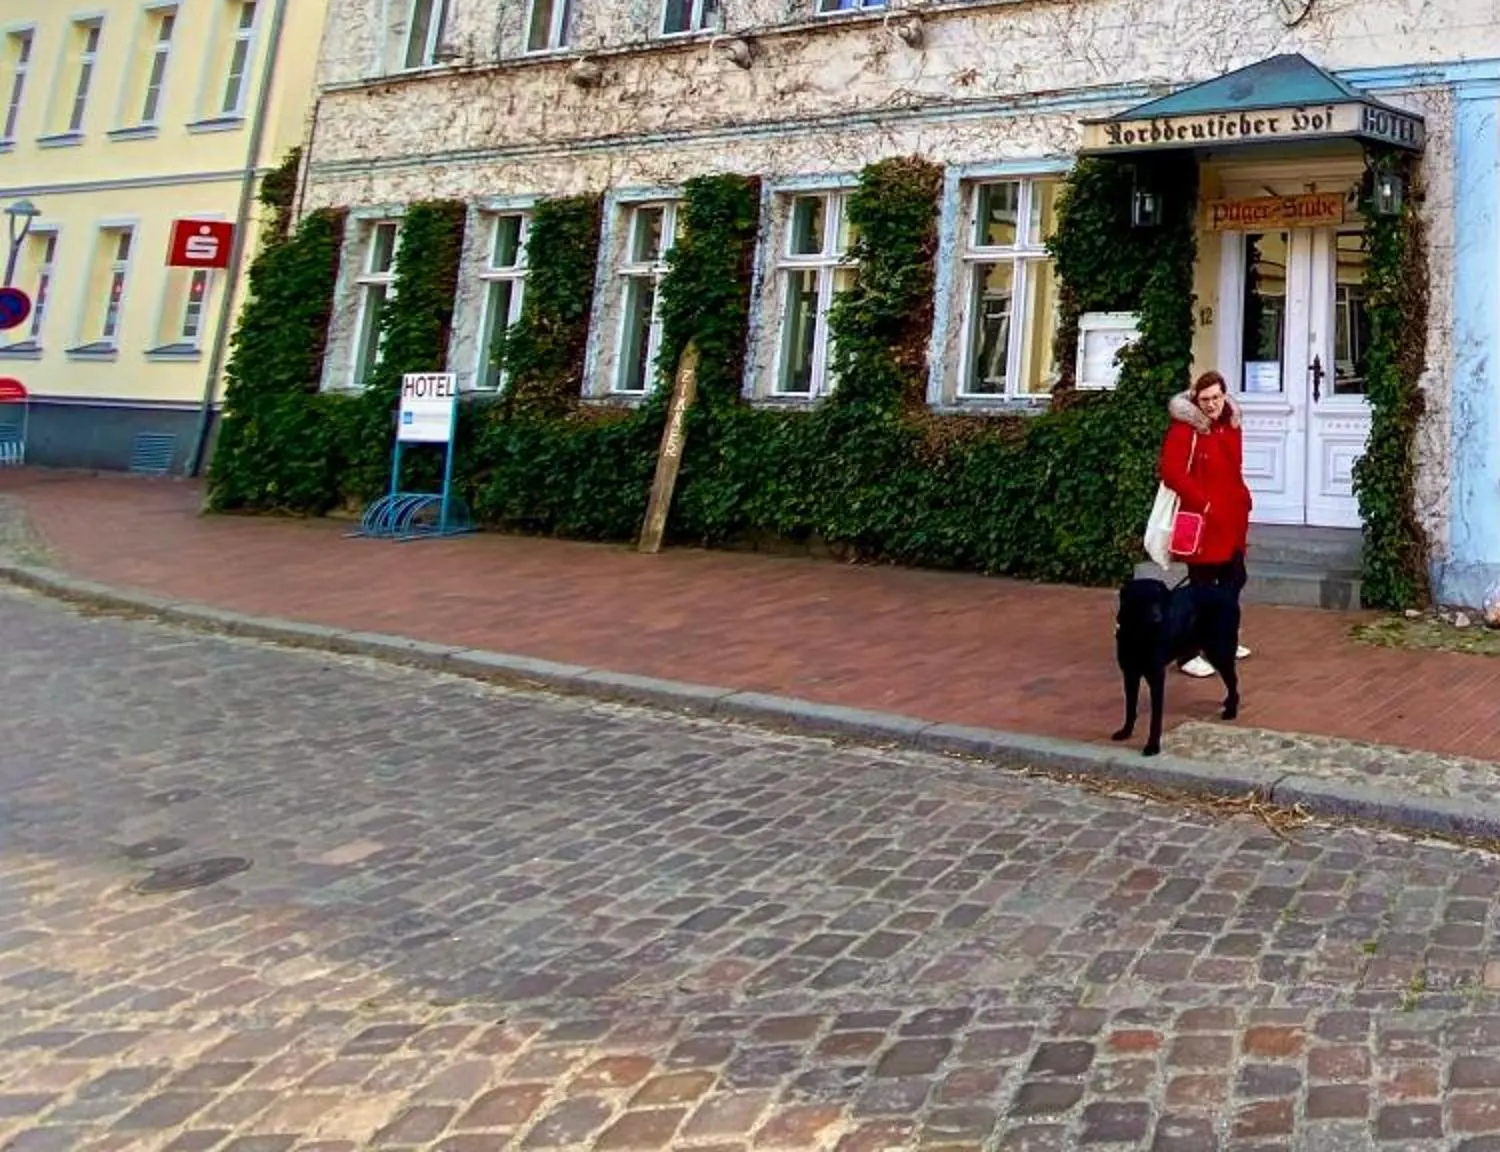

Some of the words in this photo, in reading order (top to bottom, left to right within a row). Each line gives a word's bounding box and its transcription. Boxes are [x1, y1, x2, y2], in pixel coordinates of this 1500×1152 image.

[1361, 106, 1416, 144] HOTEL
[1199, 307, 1213, 326] 12
[404, 375, 457, 397] HOTEL
